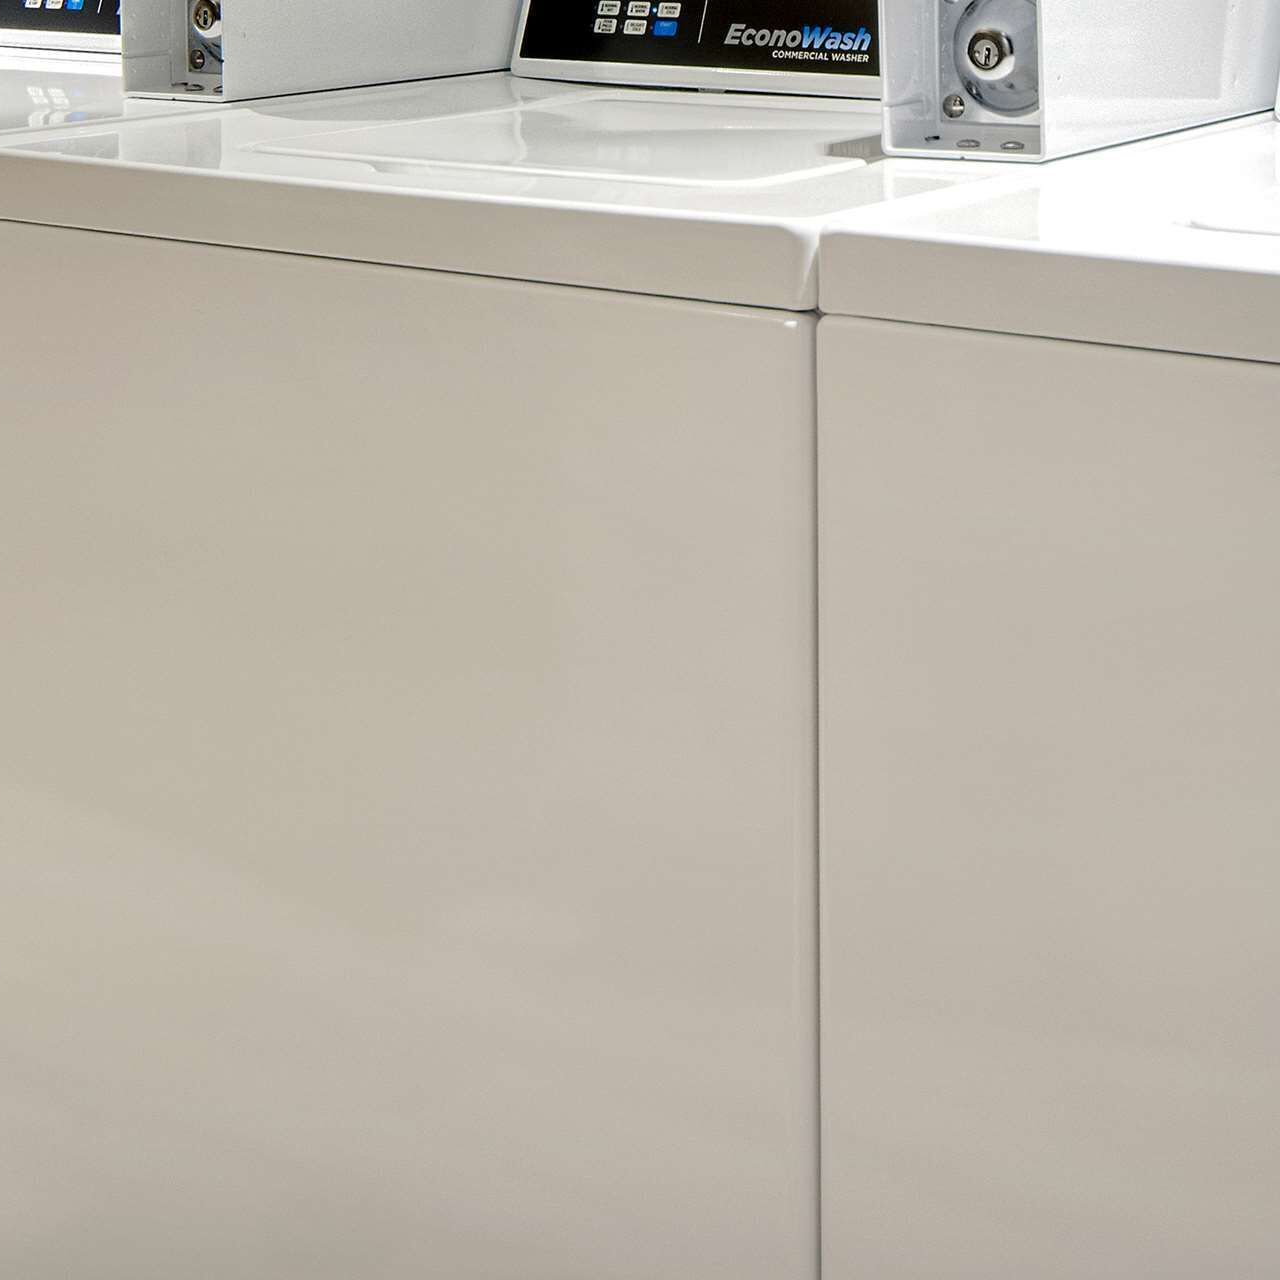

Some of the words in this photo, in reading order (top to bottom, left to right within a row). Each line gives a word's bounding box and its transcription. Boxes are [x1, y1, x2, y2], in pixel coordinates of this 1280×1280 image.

[723, 23, 872, 52] EconoWash
[772, 49, 829, 61] COMMERCIAL
[831, 52, 870, 63] WASHER
